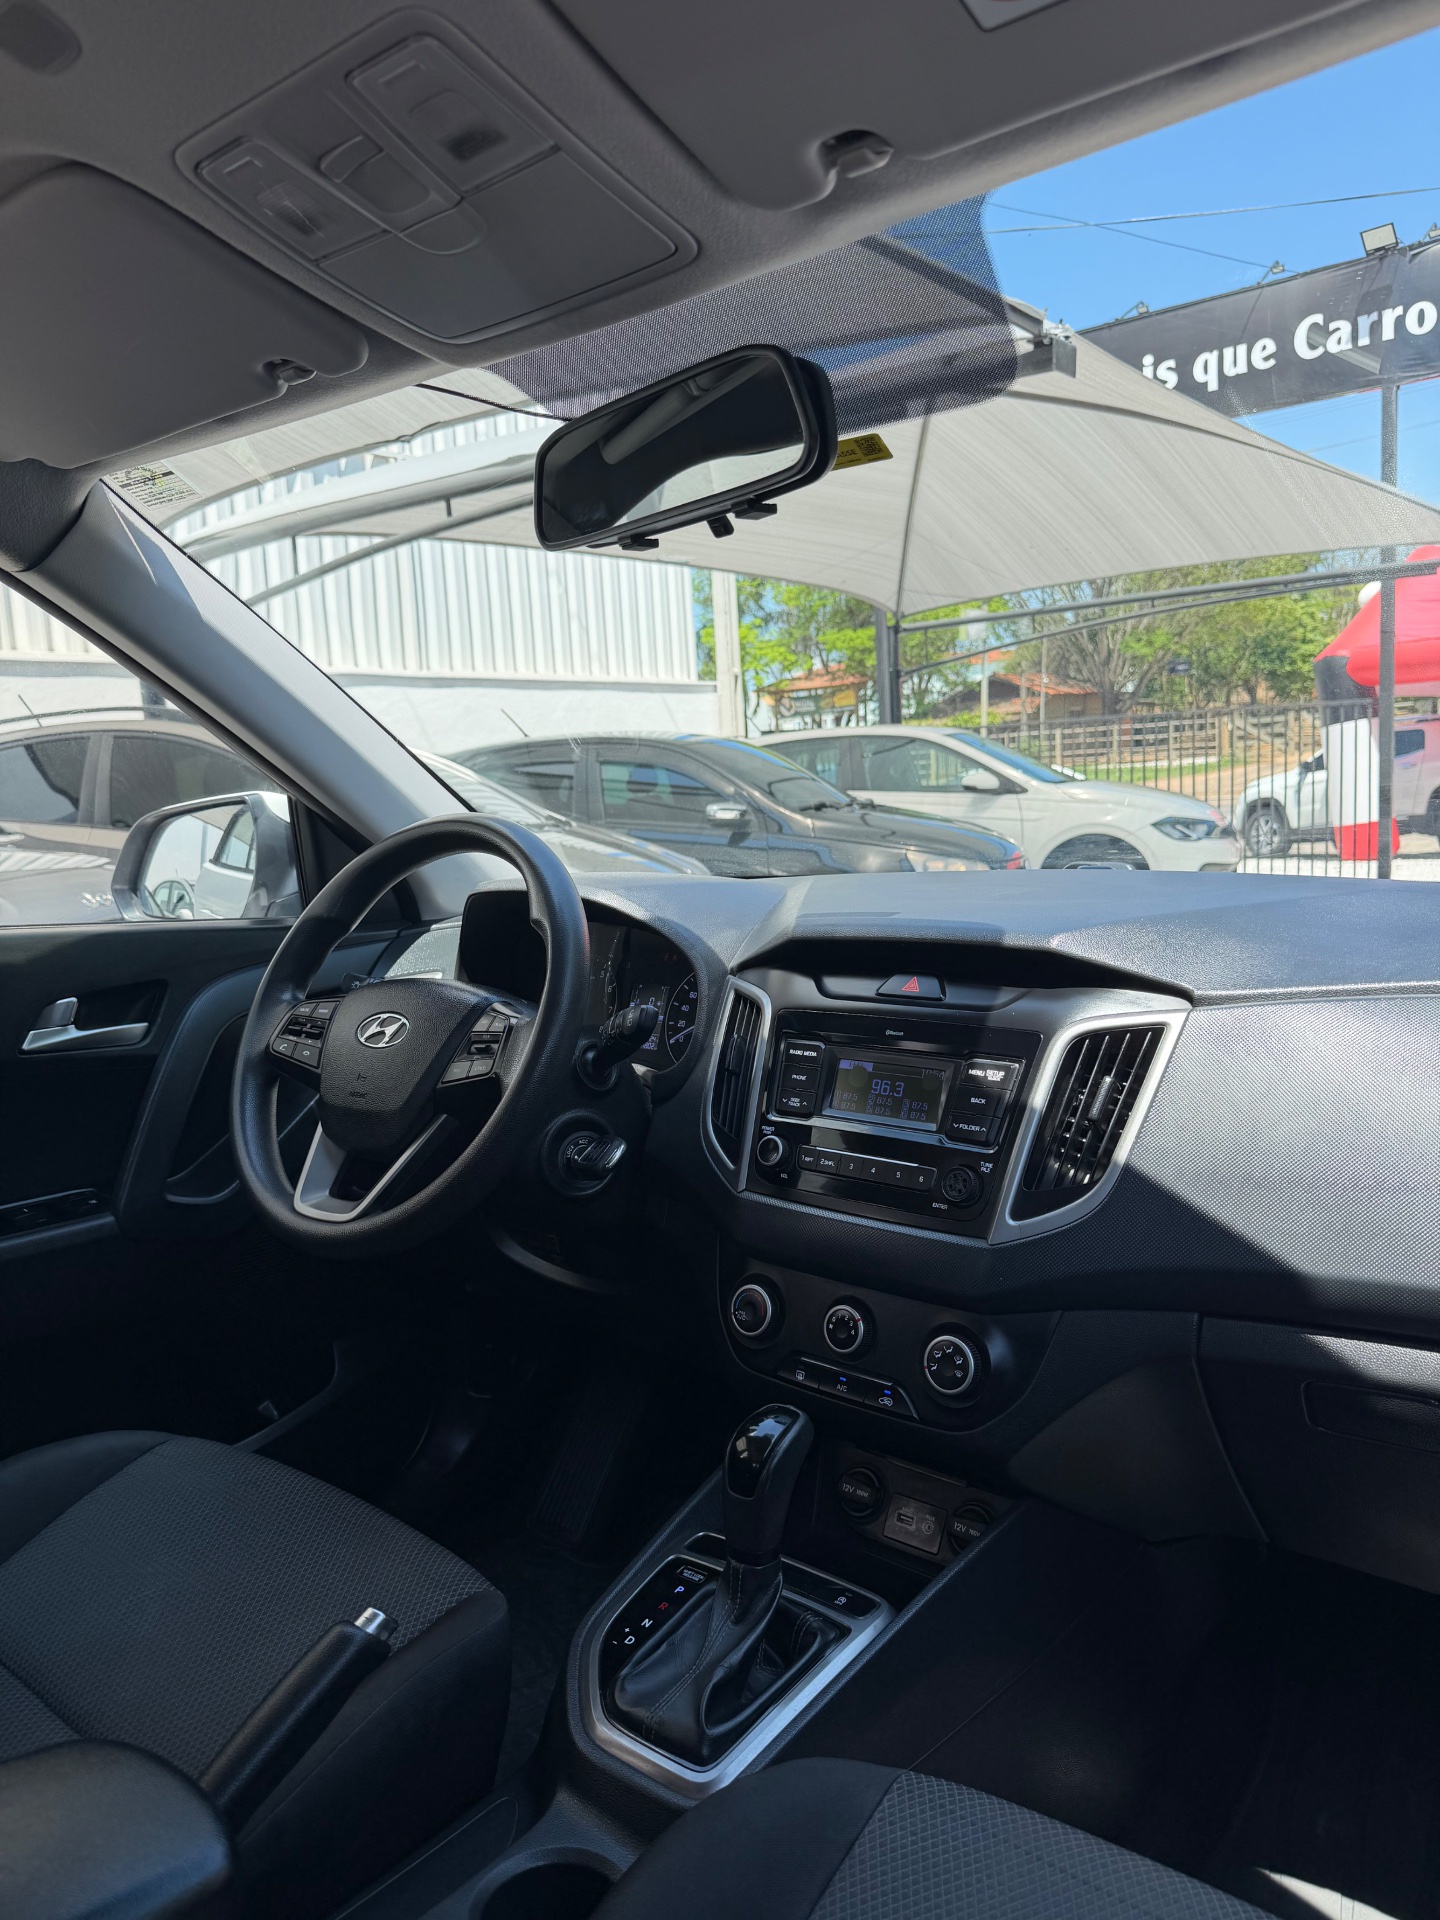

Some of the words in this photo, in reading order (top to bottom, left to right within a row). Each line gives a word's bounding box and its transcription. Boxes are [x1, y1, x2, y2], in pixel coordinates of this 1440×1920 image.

[1193, 337, 1278, 392] que
[1294, 300, 1438, 360] Carro
[608, 985, 613, 993] 6
[608, 1006, 613, 1014] 7
[681, 1004, 690, 1012] 40
[677, 1020, 686, 1028] 20
[789, 1048, 804, 1056] RADIO
[968, 1069, 985, 1077] MENU
[986, 1069, 1005, 1077] SETUP
[871, 1079, 905, 1098] 96.3
[842, 1092, 858, 1100] 87.5
[876, 1097, 893, 1106] 87.5
[911, 1101, 928, 1111] 87.5
[970, 1097, 987, 1105] BACK
[840, 1101, 856, 1110] 87.5
[874, 1107, 891, 1116] 87.5
[910, 1111, 926, 1121] 87.5
[959, 1123, 981, 1132] FOLDER
[566, 1145, 575, 1158] LOCK
[932, 1202, 948, 1210] ENTER
[836, 1383, 847, 1392] A/C
[842, 1483, 855, 1493] 12V
[925, 1514, 936, 1522] AUX
[953, 1522, 967, 1532] 12V
[674, 1585, 685, 1593] P
[658, 1602, 669, 1611] R
[640, 1618, 654, 1628] N
[623, 1635, 636, 1646] D
